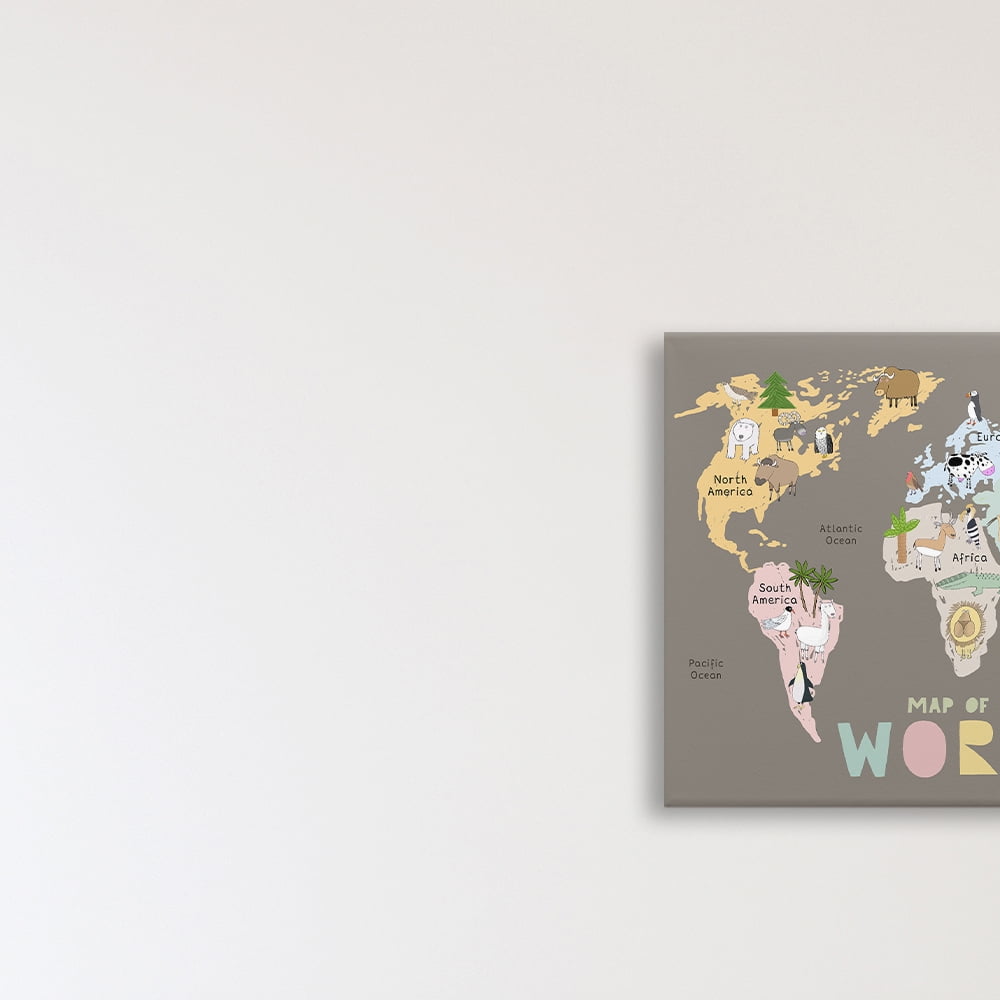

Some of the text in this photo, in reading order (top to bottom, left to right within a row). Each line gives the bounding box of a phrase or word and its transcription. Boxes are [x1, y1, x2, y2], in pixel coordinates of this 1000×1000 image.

[713, 474, 748, 485] North
[707, 486, 753, 498] America
[819, 523, 863, 534] Atlantic
[825, 535, 857, 545] Ocean
[952, 552, 988, 564] Africa
[758, 583, 792, 593] South
[752, 594, 798, 606] America
[688, 658, 724, 669] Pacific
[690, 670, 722, 680] Ocean
[907, 697, 954, 714] MAP
[965, 697, 989, 714] OF
